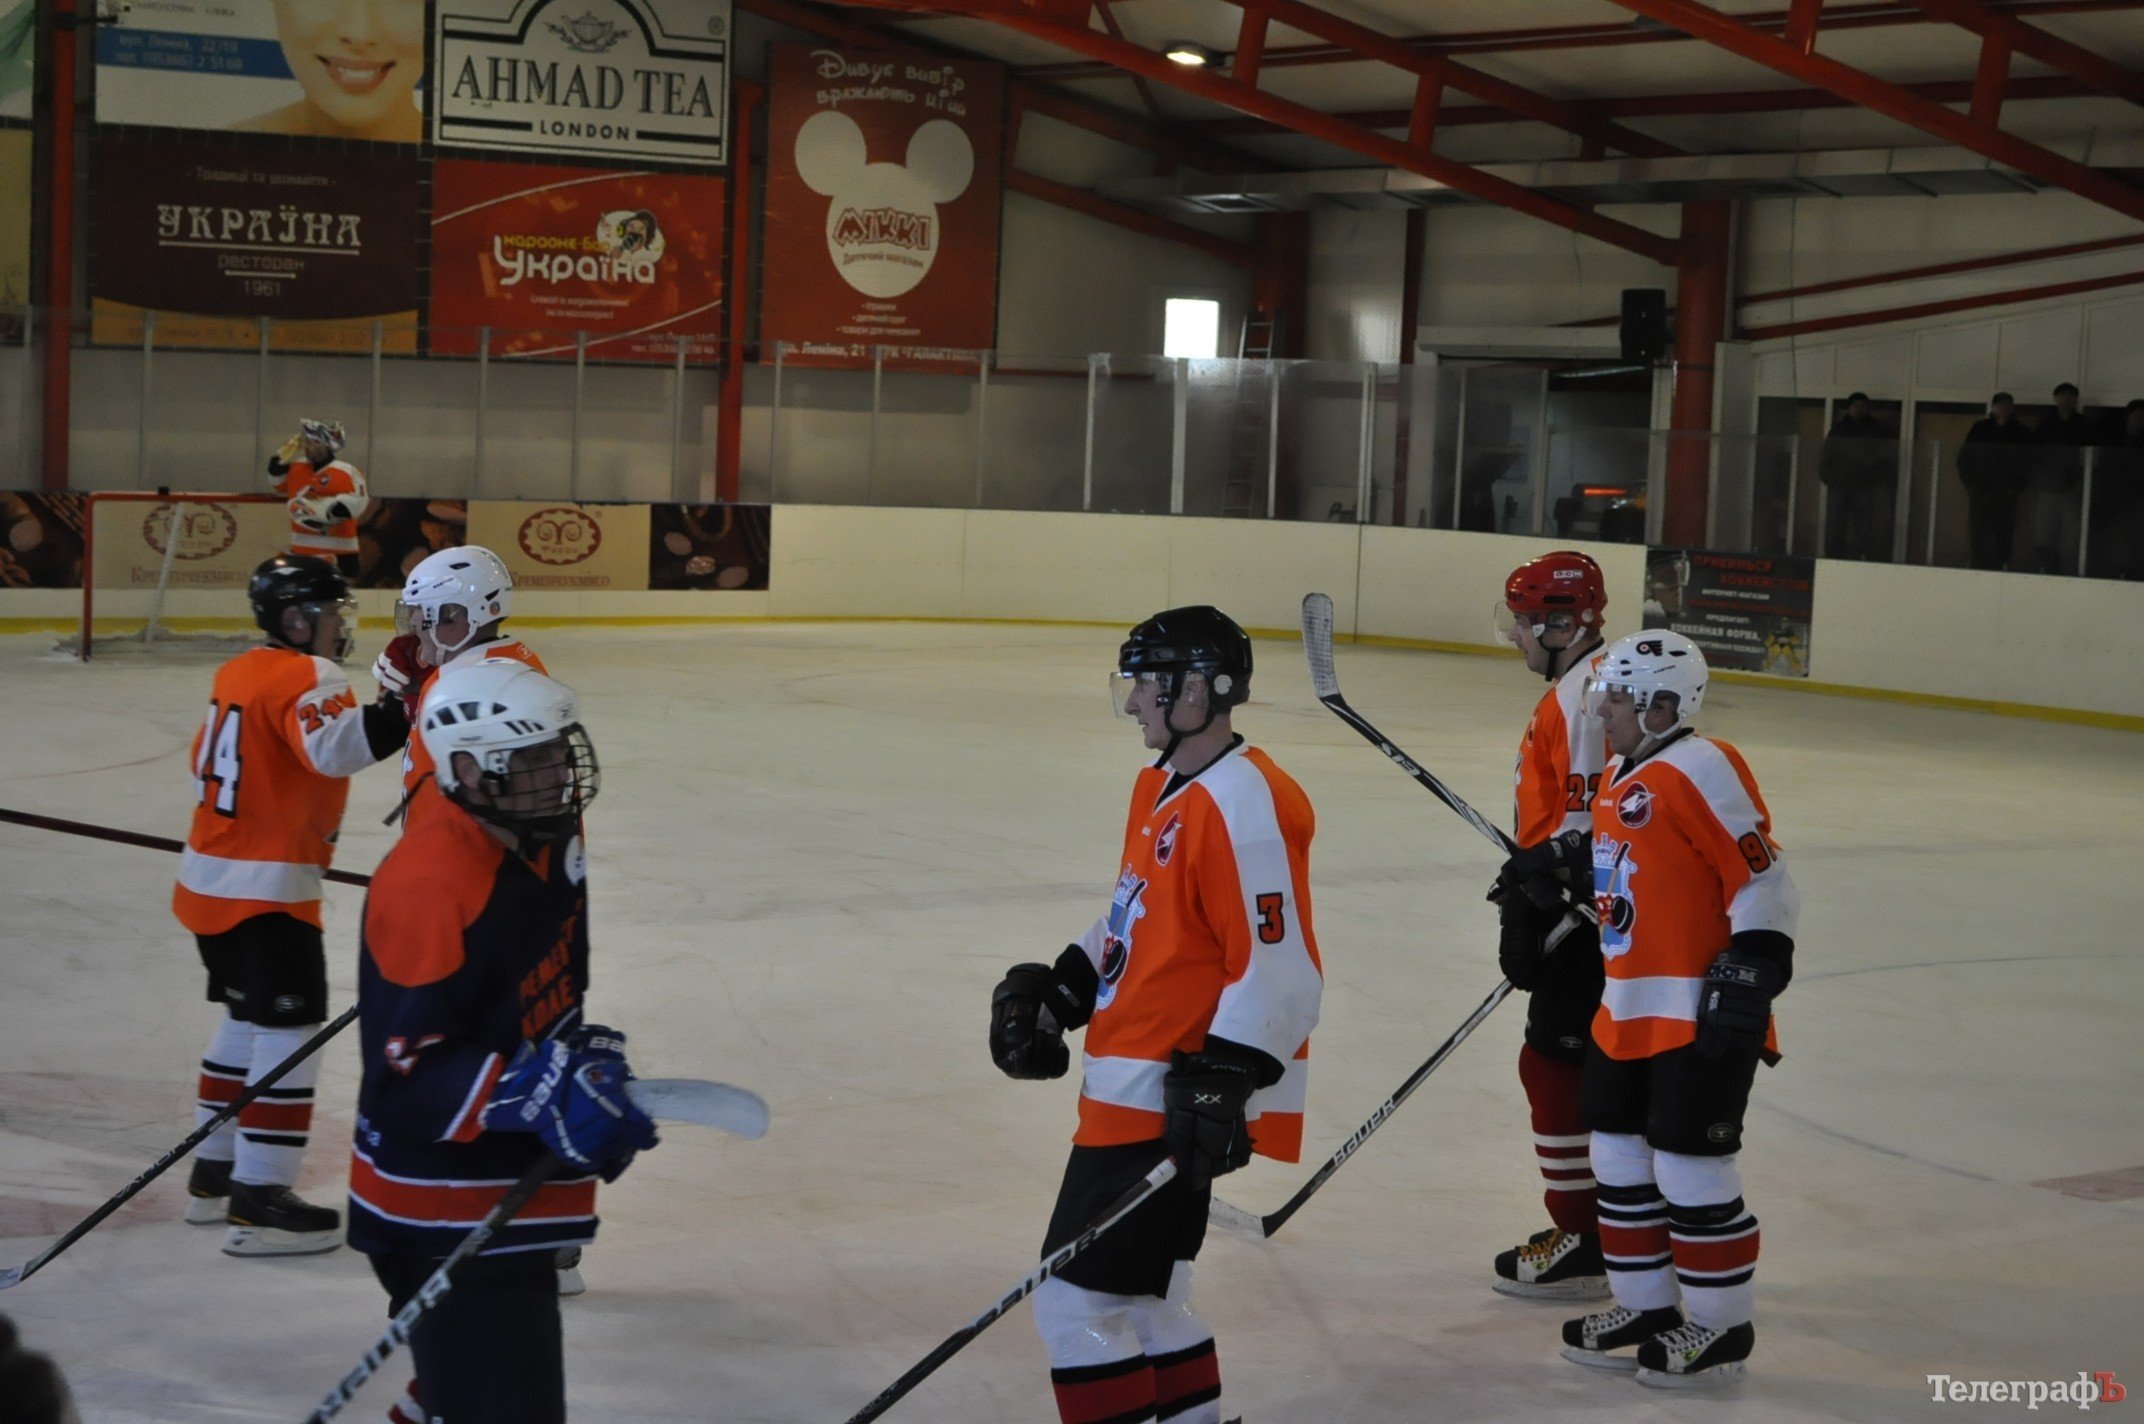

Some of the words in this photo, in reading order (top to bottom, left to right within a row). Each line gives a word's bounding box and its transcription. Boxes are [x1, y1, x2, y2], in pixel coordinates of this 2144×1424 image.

[452, 54, 625, 111] AHMAD
[633, 69, 716, 118] TEA
[540, 120, 630, 141] LONDON
[156, 203, 362, 247] УКРАЇНА
[217, 253, 305, 270] ресторан
[494, 234, 656, 286] Україна
[243, 279, 281, 298] 1961
[1738, 831, 1777, 874] 9
[1256, 892, 1285, 944] 3
[1333, 1098, 1396, 1166] BAUER
